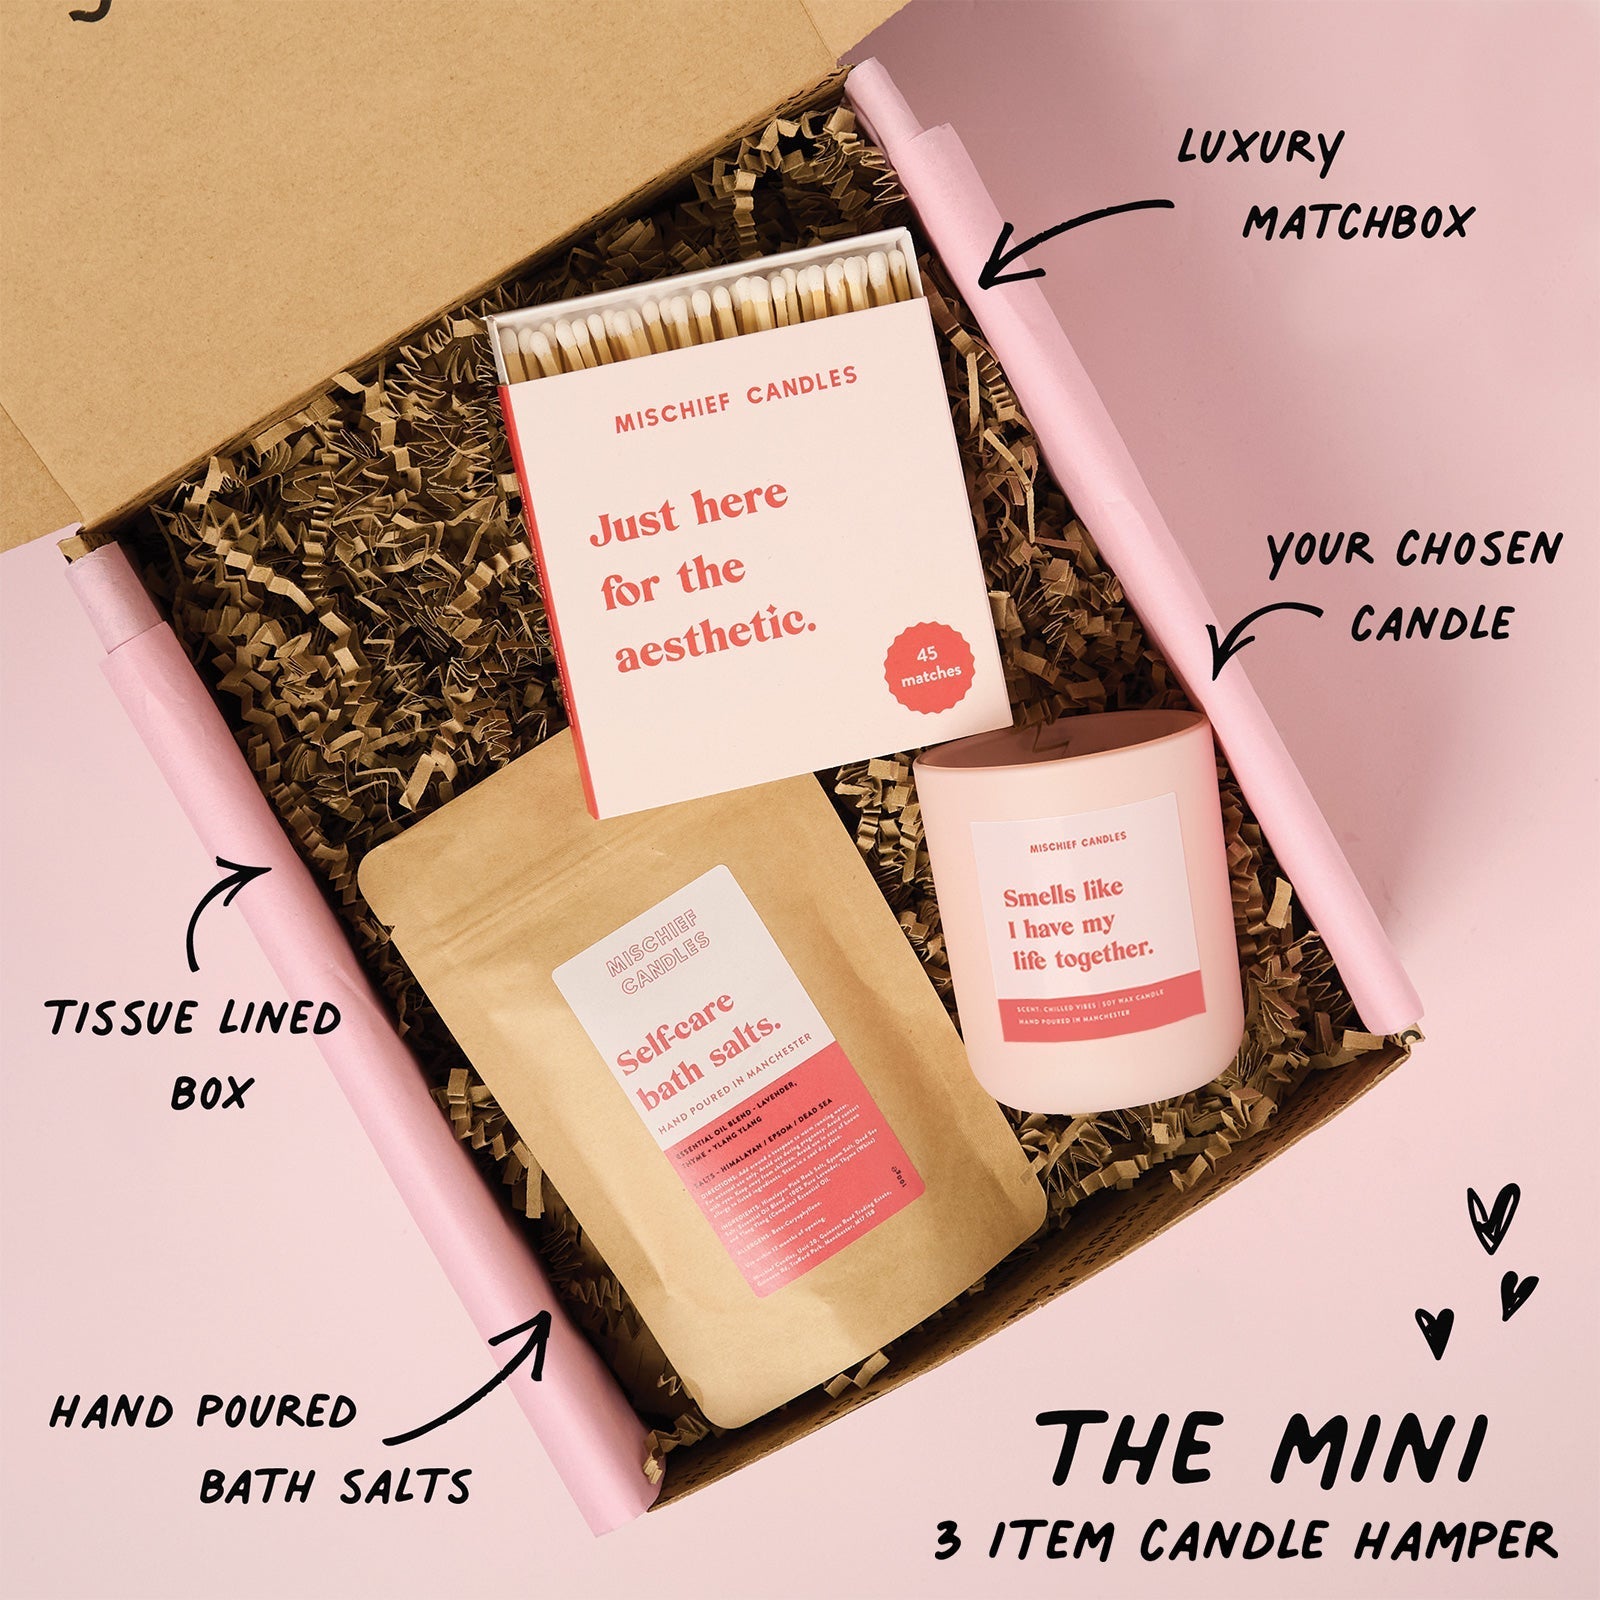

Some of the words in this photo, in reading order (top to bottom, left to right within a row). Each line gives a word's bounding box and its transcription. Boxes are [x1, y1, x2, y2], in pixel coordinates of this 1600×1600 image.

[615, 392, 729, 434] MISCHIEF
[747, 366, 857, 404] CANDLES
[589, 501, 678, 547] Just
[692, 484, 788, 524] here
[601, 574, 660, 611] for
[677, 555, 745, 593] the
[615, 604, 817, 673] aesthetic.
[916, 646, 938, 663] 45
[901, 664, 963, 689] matches
[1030, 840, 1078, 854] MISCHIEF
[1081, 831, 1128, 848] CANDLES
[1003, 883, 1076, 907] Smells
[1082, 878, 1124, 901] like
[605, 908, 696, 977] MISCHIEF
[1007, 921, 1017, 939] I
[1023, 919, 1075, 939] have
[1082, 913, 1116, 935] my
[621, 930, 710, 994] CANDLES
[1013, 950, 1048, 971] life
[1054, 939, 1154, 973] together.
[1041, 1017, 1071, 1025] POURED
[1083, 1009, 1130, 1023] MANCHESTER
[1043, 1005, 1074, 1013] CHILLED
[1075, 1002, 1097, 1010] VIBES
[1101, 1000, 1116, 1008] SOY
[1117, 996, 1134, 1004] WAX
[1135, 989, 1165, 1001] CANDLE
[617, 994, 733, 1076] Self-care
[636, 1060, 704, 1111] bath
[709, 1017, 781, 1067] salts.
[657, 1112, 687, 1134] HAND
[689, 1085, 730, 1115] POURED
[731, 1075, 744, 1087] IN
[746, 1032, 811, 1079] MANCHESTER
[713, 1125, 727, 1135] OIL
[727, 1109, 751, 1127] BLEND
[756, 1081, 797, 1108] LAVENDER,
[720, 1142, 762, 1172] HIMALAYAN
[767, 1123, 793, 1142] EPSOM
[797, 1106, 817, 1122] DEAD
[818, 1098, 832, 1109] SEA
[681, 1151, 707, 1168] THYME
[712, 1131, 737, 1149] YLANG
[737, 1115, 762, 1134] YLANG
